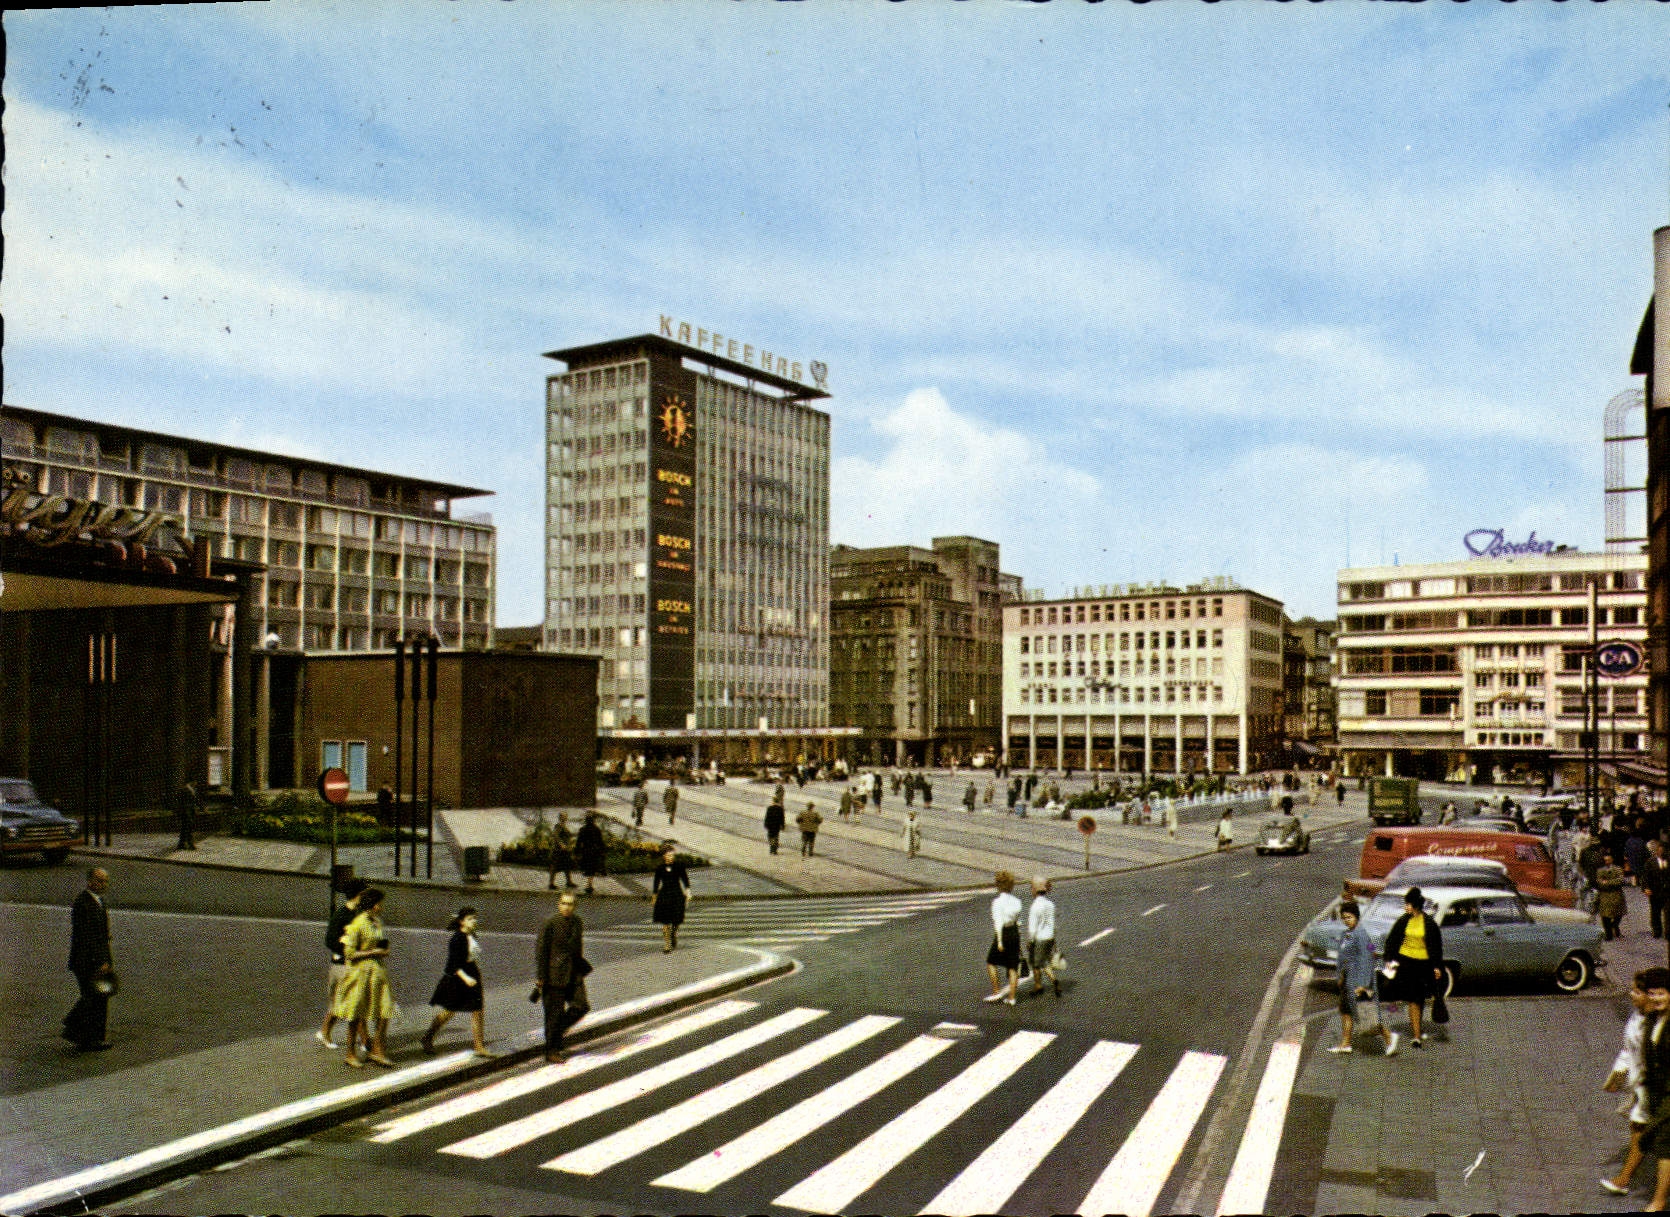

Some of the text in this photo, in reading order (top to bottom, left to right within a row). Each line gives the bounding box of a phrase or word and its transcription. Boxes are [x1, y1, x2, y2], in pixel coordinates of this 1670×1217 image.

[657, 469, 691, 486] BOSCH
[657, 534, 691, 550] BOSCH
[657, 599, 690, 613] BOSCH
